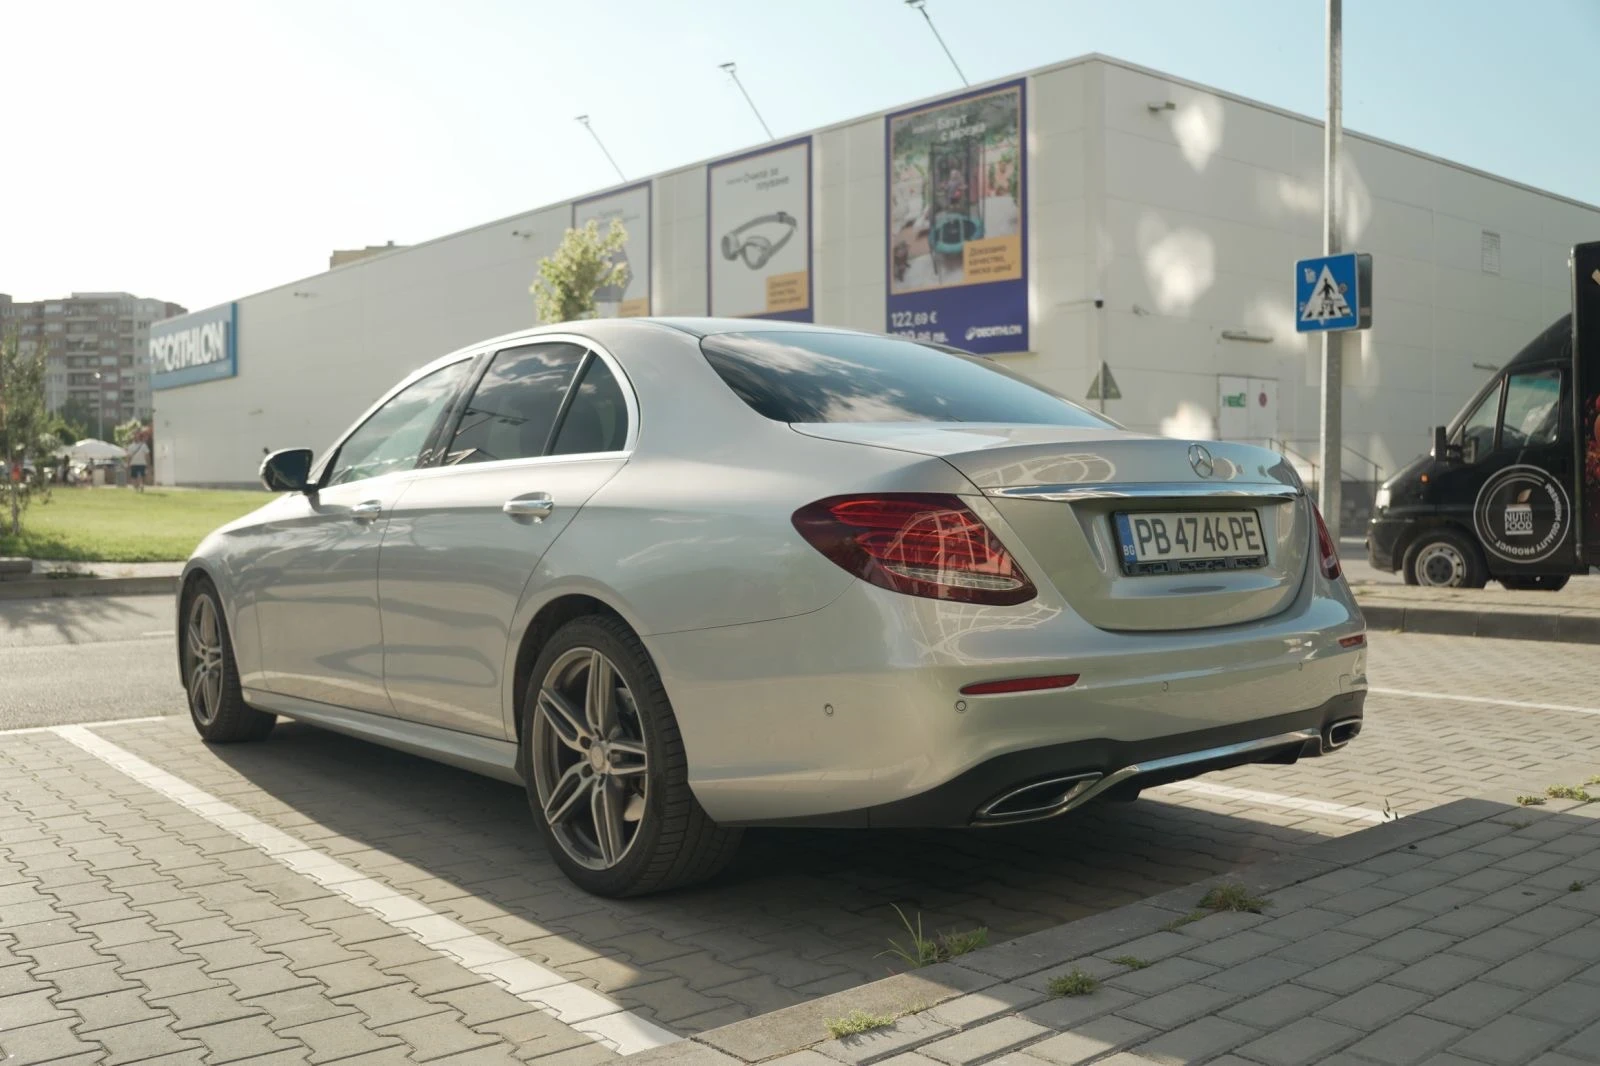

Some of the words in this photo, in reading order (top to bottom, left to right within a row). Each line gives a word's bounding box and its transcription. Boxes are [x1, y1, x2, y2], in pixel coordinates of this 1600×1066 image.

[1504, 512, 1532, 522] NUTRI
[1504, 522, 1533, 531] FOOD
[1134, 518, 1171, 556] PB
[1175, 517, 1229, 553] 4746
[1228, 516, 1260, 551] PE
[1536, 521, 1560, 552] QUALITY
[1123, 544, 1135, 556] BG
[1495, 540, 1535, 555] PRODUCT
